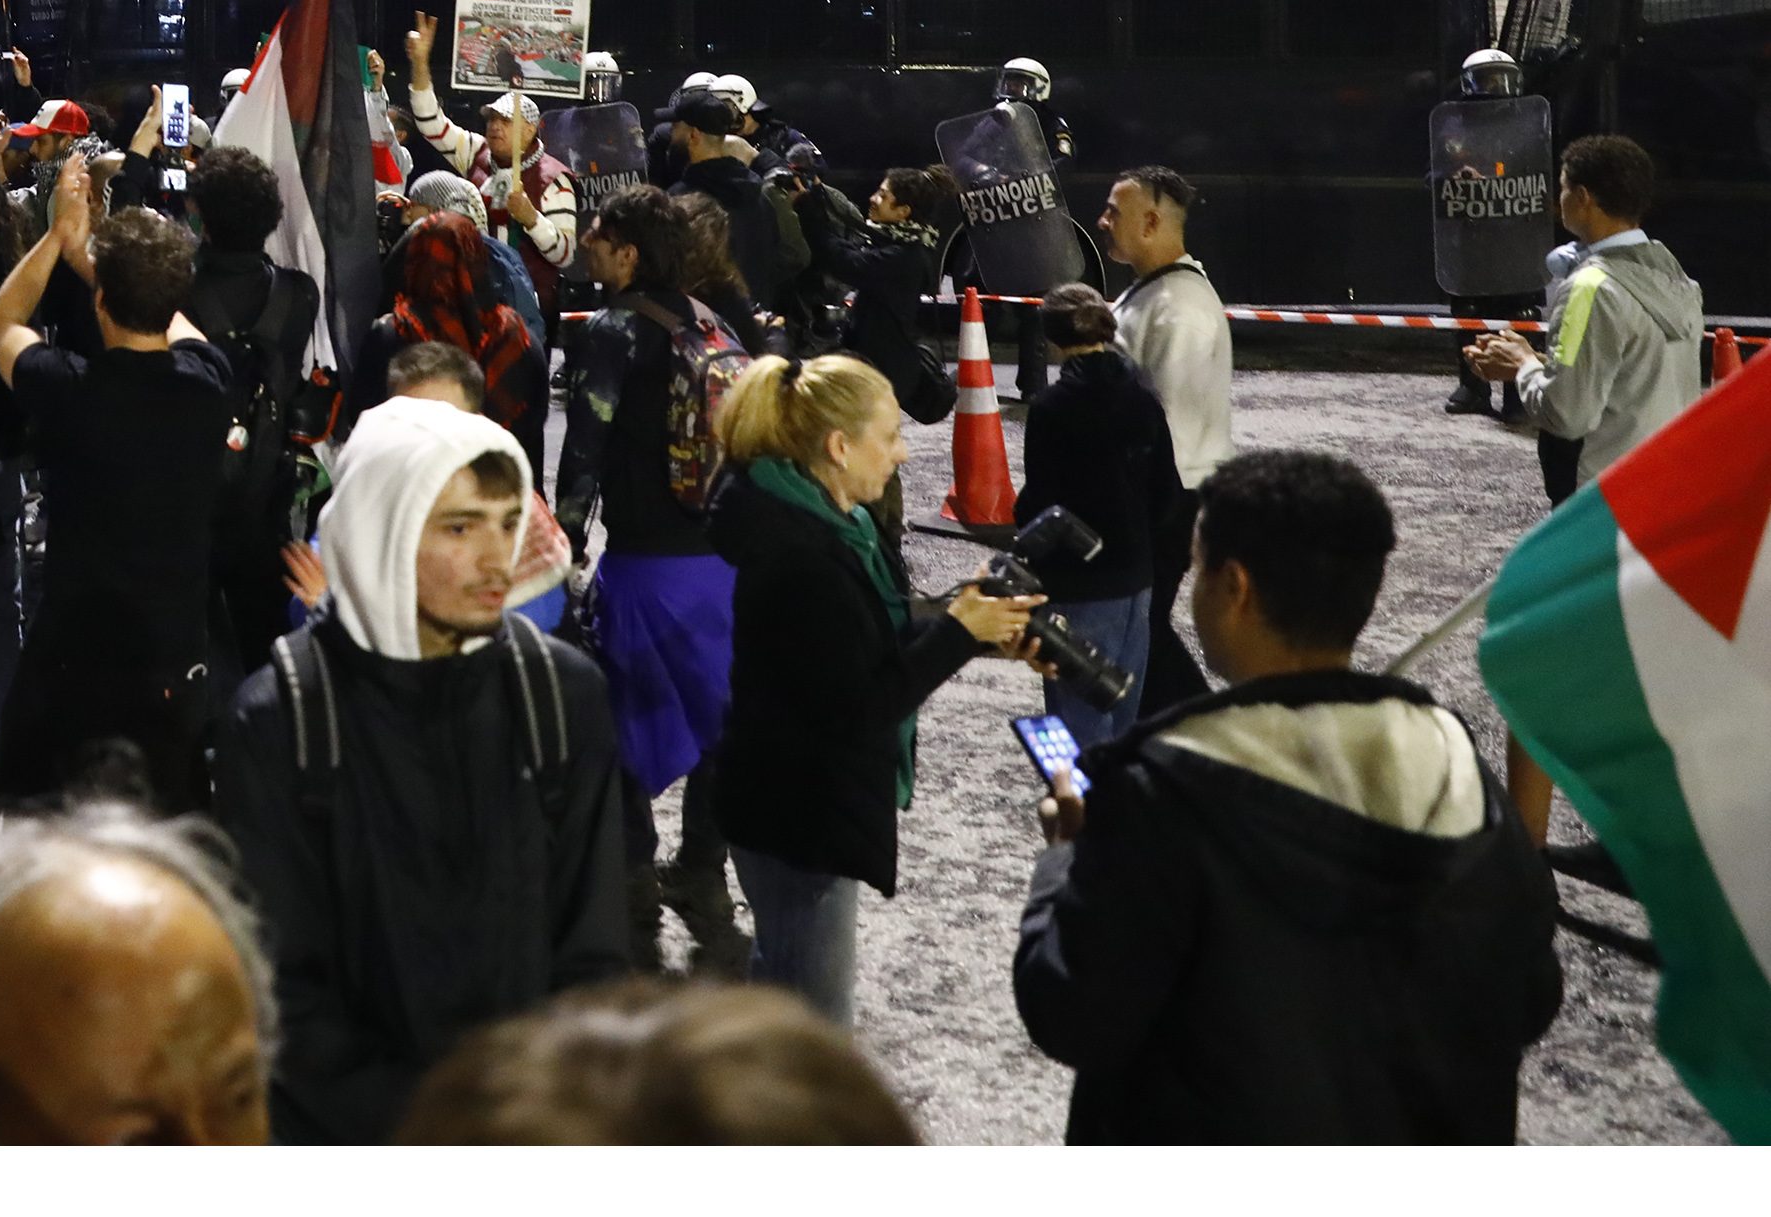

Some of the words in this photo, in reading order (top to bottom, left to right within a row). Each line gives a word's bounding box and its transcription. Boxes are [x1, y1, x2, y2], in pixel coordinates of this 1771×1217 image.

[578, 170, 642, 196] ΥΝΟΜΙΑ
[960, 173, 1056, 212] ΑΣΤΥΝΟΜΙΑ
[1441, 172, 1547, 201] ΑΣΤΥΝΟΜΙΑ
[967, 192, 1056, 226] POLICE
[1447, 194, 1544, 218] POLICE
